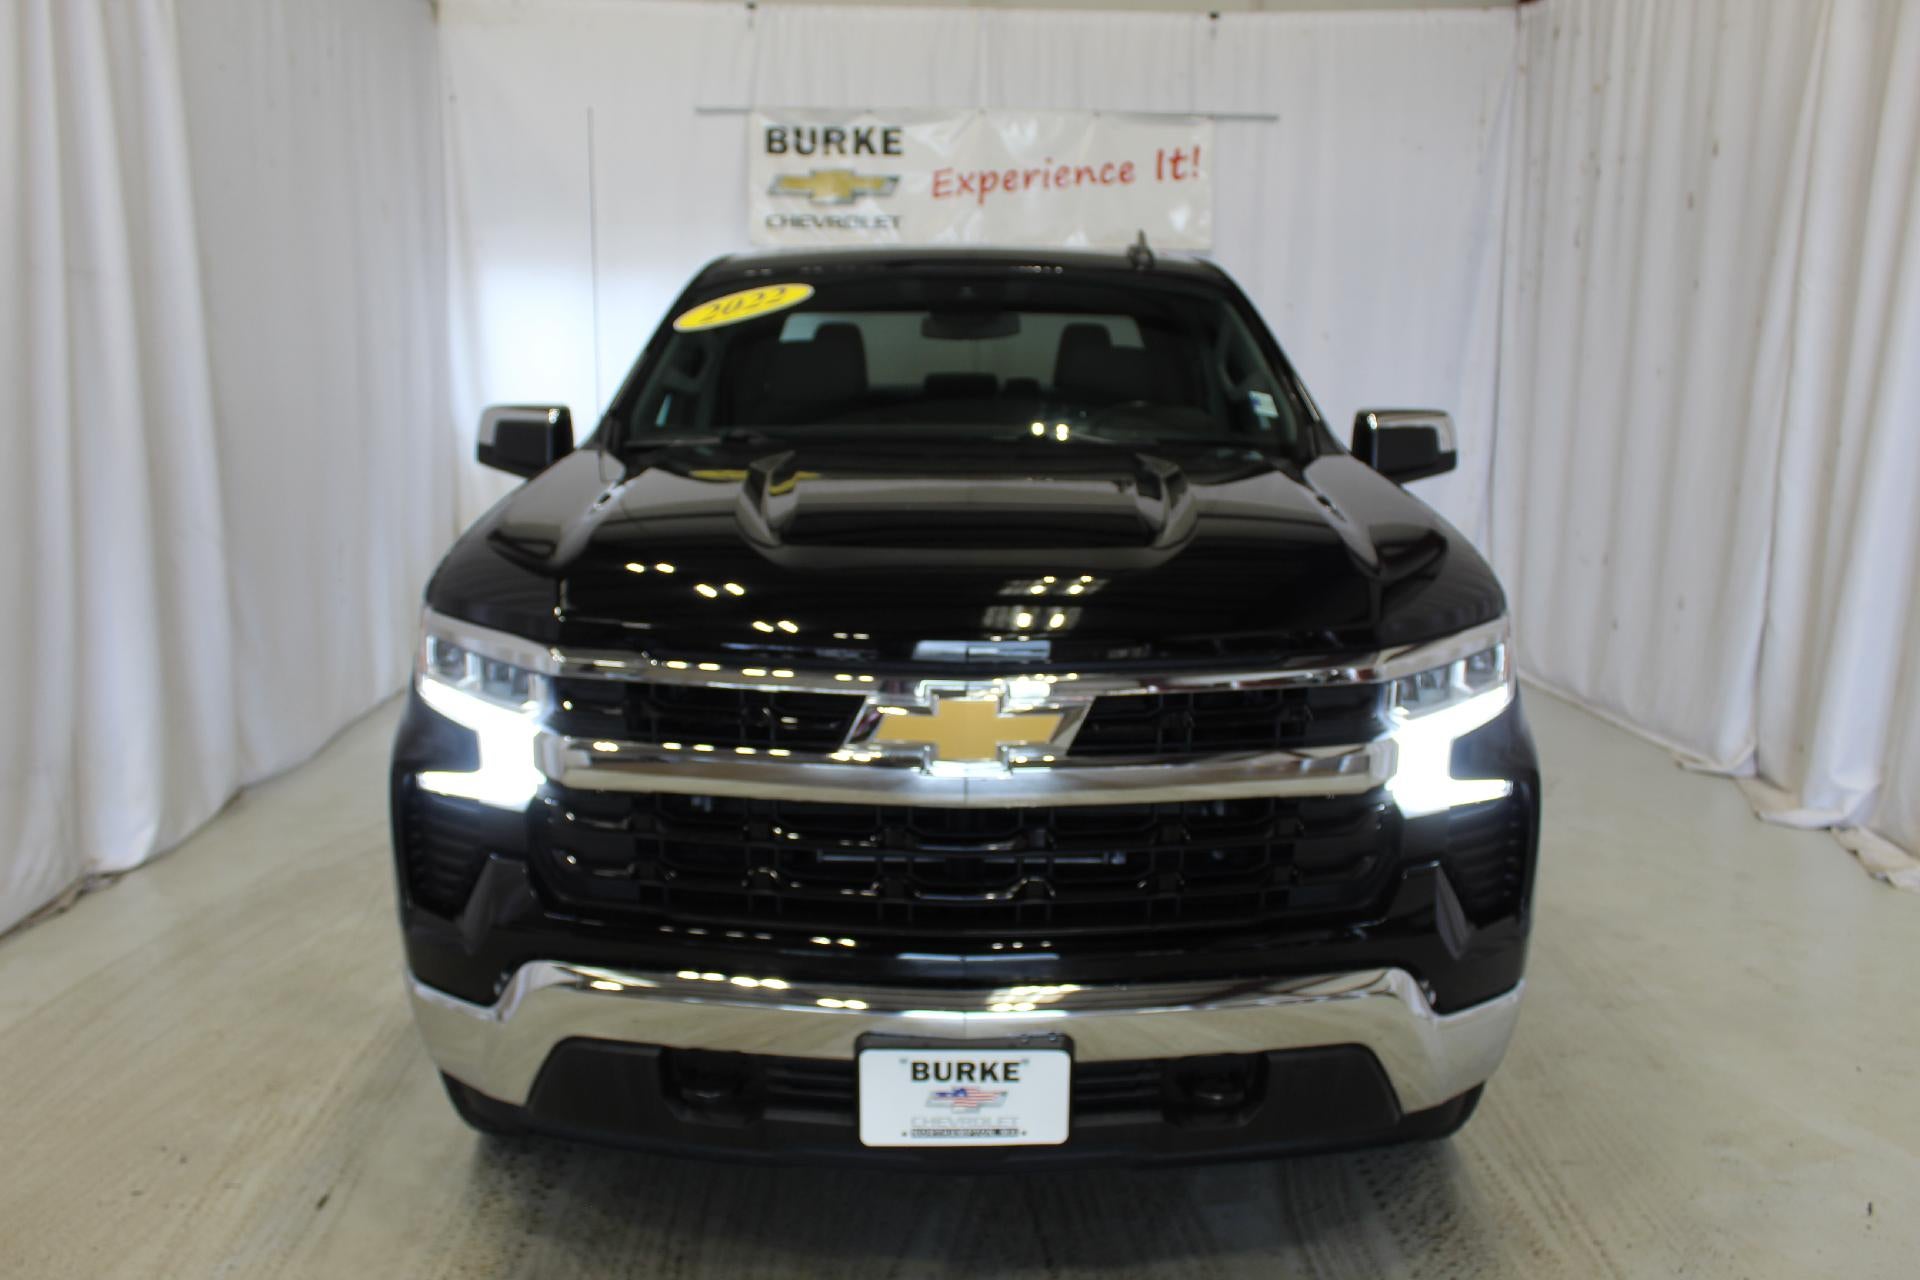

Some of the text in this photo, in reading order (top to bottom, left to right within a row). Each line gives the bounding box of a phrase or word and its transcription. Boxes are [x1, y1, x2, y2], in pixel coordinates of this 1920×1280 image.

[766, 127, 902, 155] BURKE
[931, 145, 1202, 203] Experience It!
[765, 213, 901, 229] CHEVROLET
[699, 286, 786, 324] 2022
[911, 1061, 1021, 1082] BURKE
